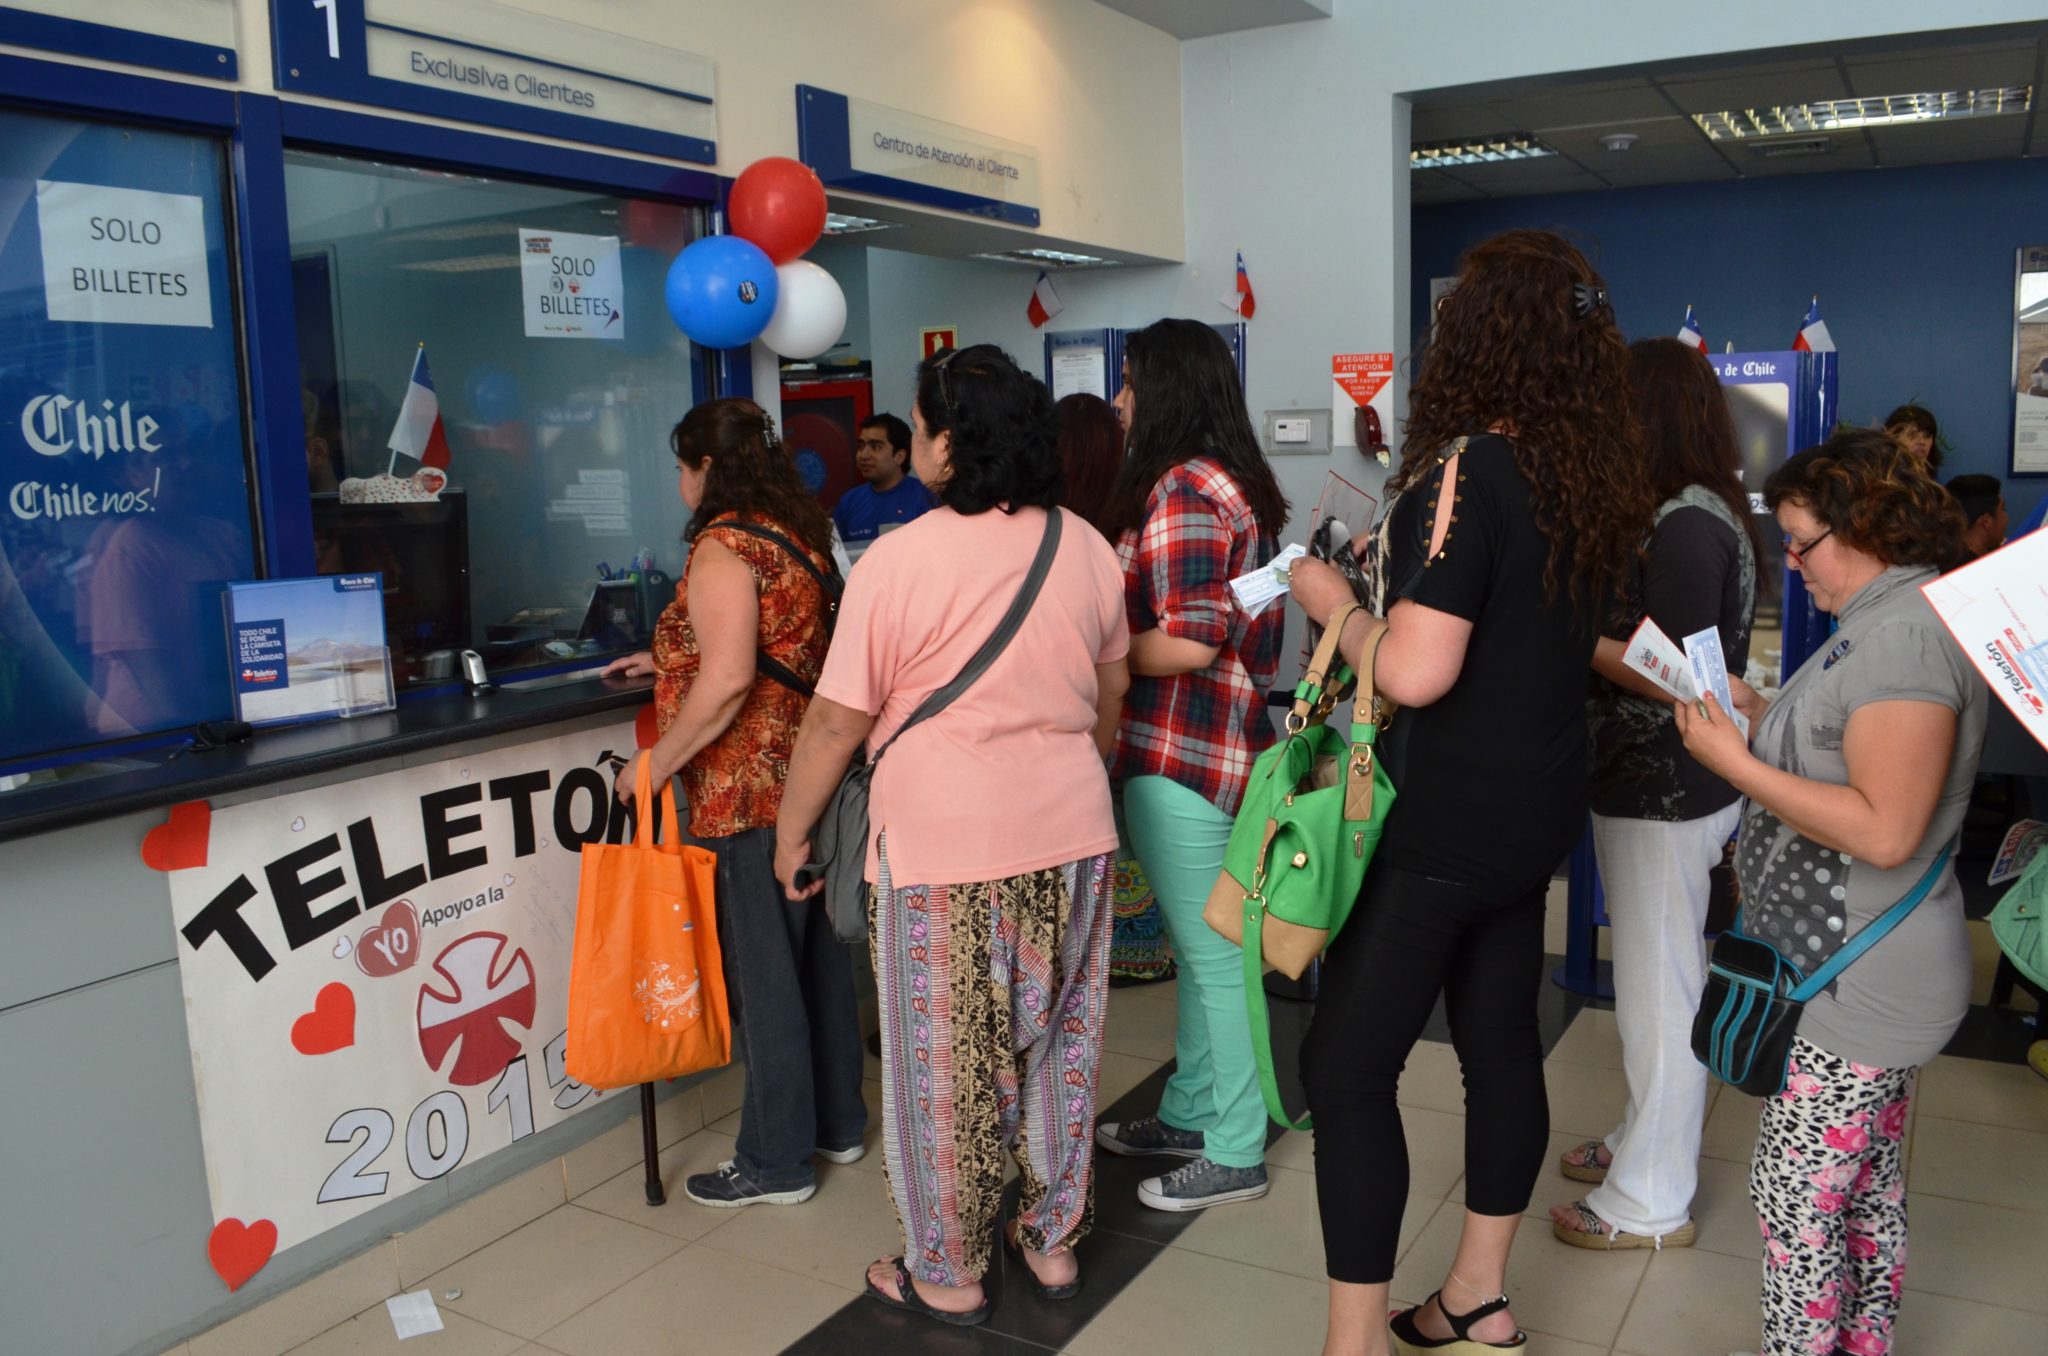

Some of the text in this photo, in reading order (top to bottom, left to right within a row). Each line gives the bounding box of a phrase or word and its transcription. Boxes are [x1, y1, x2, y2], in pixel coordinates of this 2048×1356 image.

[312, 0, 341, 60] 1
[410, 50, 597, 109] Exclusiva Clientes
[873, 132, 1020, 181] Centro de Atención al Cliente
[90, 216, 162, 246] SOLO
[551, 255, 596, 277] SOLO
[72, 266, 189, 297] BILLETES
[540, 295, 611, 317] BILLETES
[1336, 354, 1390, 363] ASEGURE SU
[1342, 363, 1384, 371] ATENCION
[1724, 362, 1739, 377] de
[1742, 360, 1777, 378] Chile
[21, 393, 163, 461] Chile
[239, 627, 277, 637] TODO CHILE
[249, 635, 267, 643] PONE
[240, 640, 282, 651] LA CAMISETA
[240, 649, 250, 657] DE
[240, 653, 285, 664] SOLIDARIDAD
[1985, 641, 2025, 696] Teletón
[373, 886, 506, 968] YO Apoyo a la
